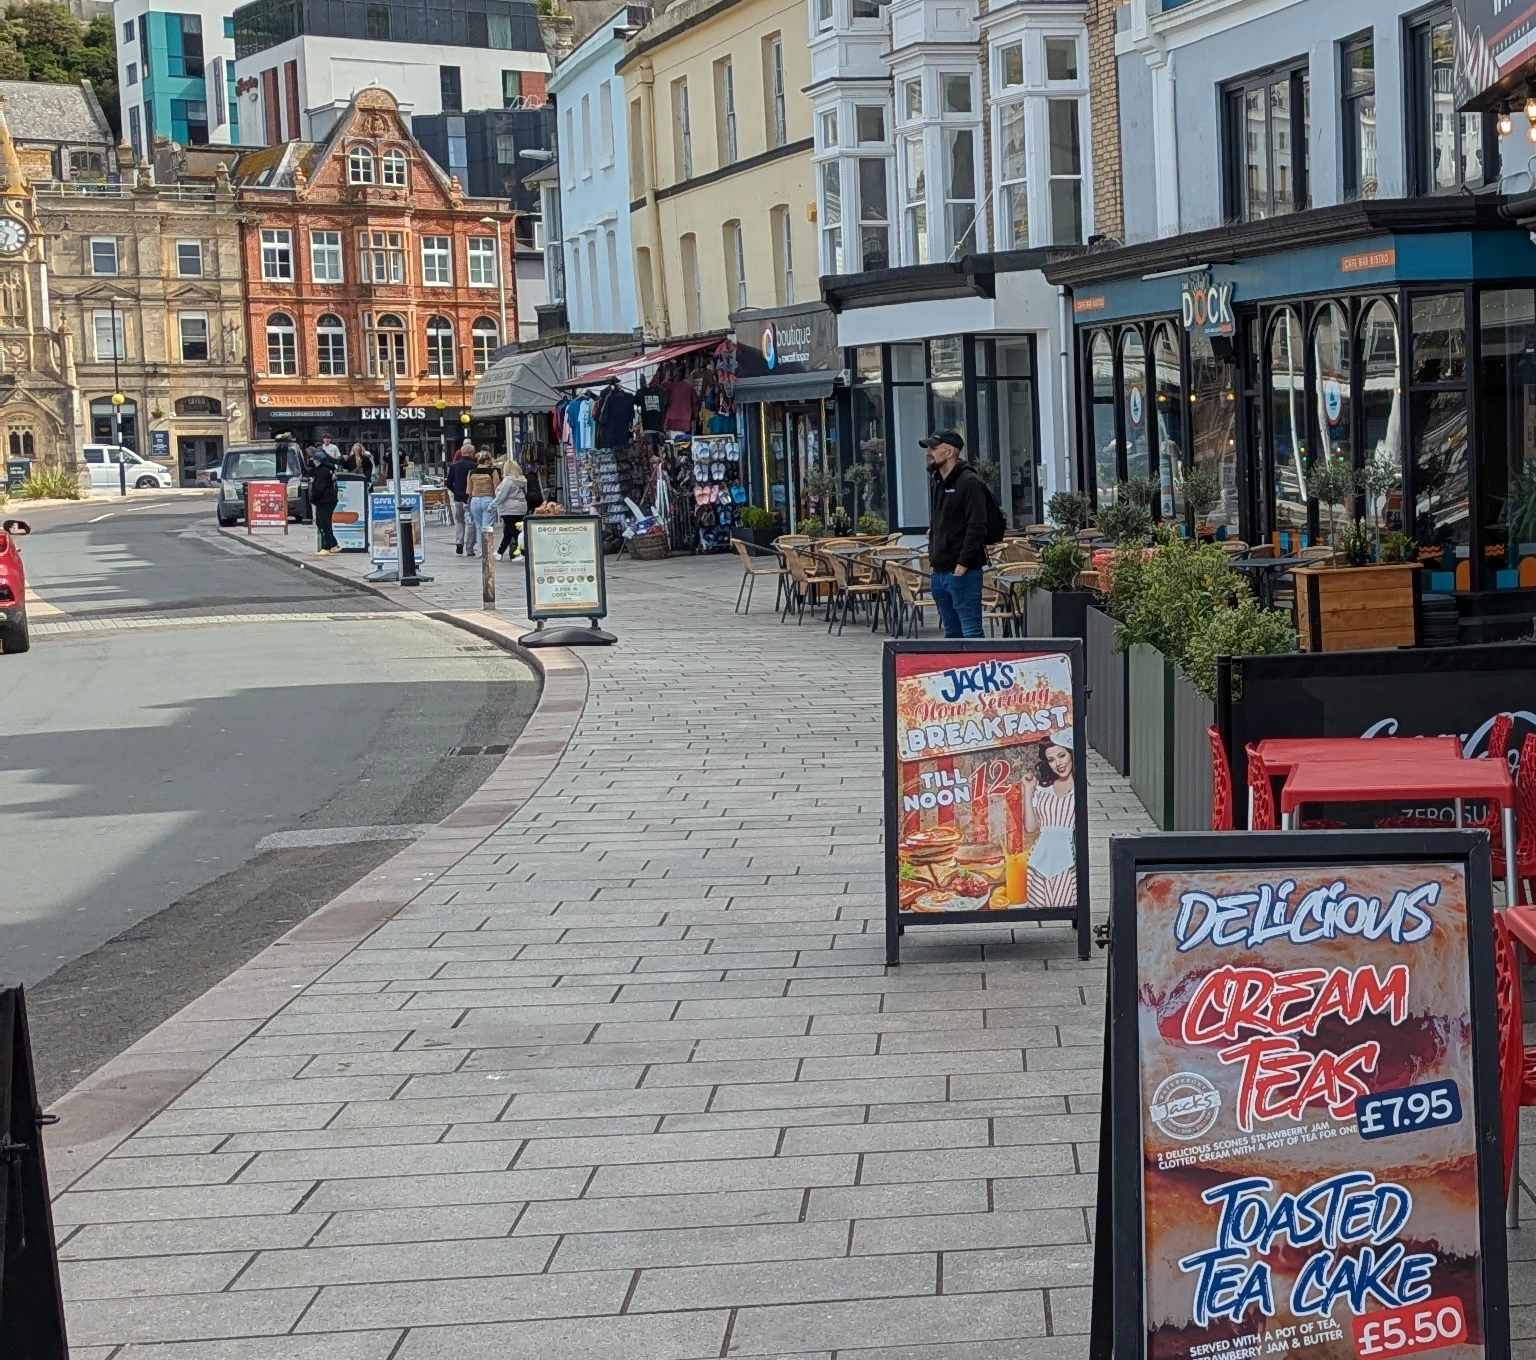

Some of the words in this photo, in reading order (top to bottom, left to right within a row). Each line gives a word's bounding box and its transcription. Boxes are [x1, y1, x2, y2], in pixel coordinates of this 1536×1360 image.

[1182, 286, 1231, 327] DOCK
[776, 324, 811, 351] boutique
[940, 659, 1015, 703] JACK'S
[975, 686, 1051, 713] Serving
[907, 705, 1069, 753] BREAKFAST
[904, 787, 971, 811] NOON
[920, 768, 968, 789] TILL
[971, 760, 1012, 802] 12
[1183, 965, 1411, 1044] CREAM
[1219, 1039, 1380, 1133] TEAS
[1360, 1087, 1453, 1134] £7.95
[1157, 1153, 1164, 1162] 2
[1165, 1144, 1211, 1160] DELICIOUS
[1213, 1136, 1249, 1151] SCONES
[1250, 1125, 1308, 1144] STRAWBERRY
[1311, 1121, 1330, 1133] JAM
[1158, 1155, 1197, 1170] CLOTTED
[1199, 1150, 1231, 1163] CREAM
[1232, 1145, 1256, 1157] WITH
[1257, 1143, 1266, 1152] A
[1267, 1138, 1285, 1150] POT
[1286, 1135, 1299, 1146] OF
[1301, 1131, 1317, 1143] TEA
[1319, 1128, 1337, 1140] FOR
[1339, 1124, 1358, 1137] ONE
[1201, 1171, 1413, 1256] TOASTED
[1181, 1248, 1274, 1327] TEA
[1290, 1243, 1439, 1319] CAKE
[1189, 1341, 1231, 1358] SERVED
[1232, 1334, 1261, 1349] WITH
[1264, 1331, 1273, 1341] A
[1275, 1326, 1298, 1339] POT
[1300, 1322, 1316, 1335] OF
[1319, 1318, 1341, 1332] TEA,
[1266, 1341, 1289, 1355] JAM
[1291, 1337, 1301, 1348] &
[1304, 1329, 1344, 1346] BUTTER
[1358, 1306, 1462, 1356] £5.50
